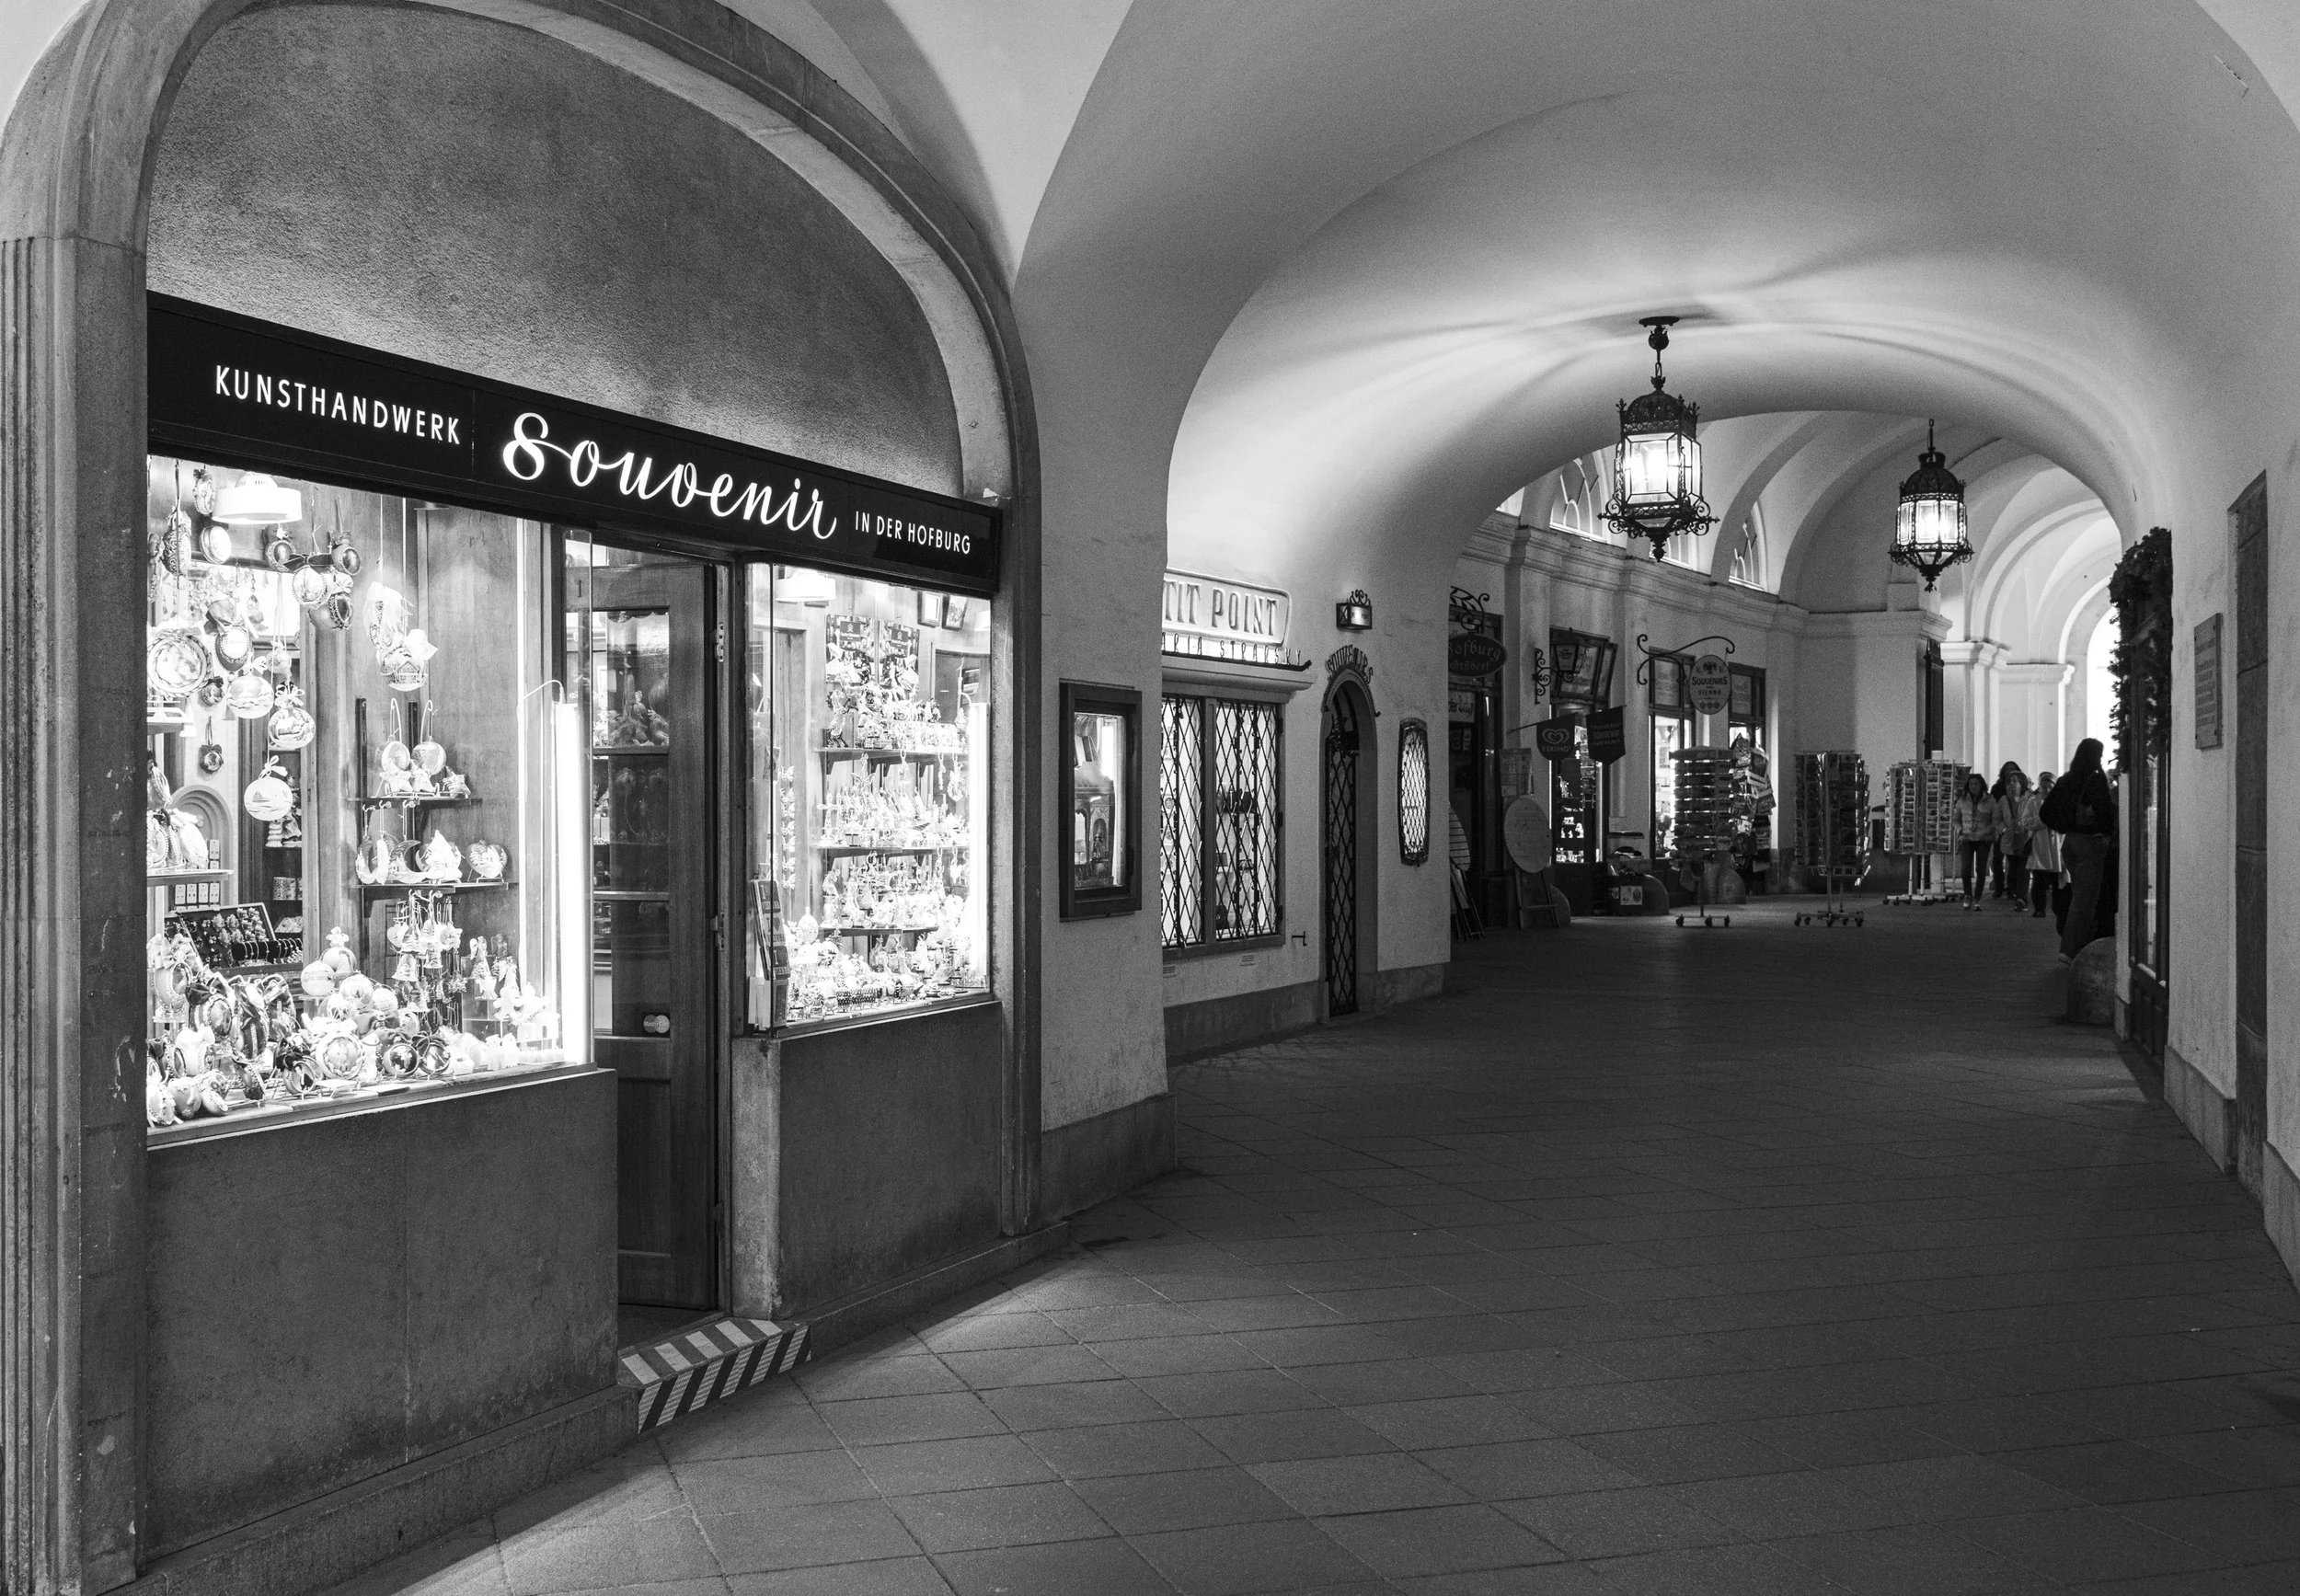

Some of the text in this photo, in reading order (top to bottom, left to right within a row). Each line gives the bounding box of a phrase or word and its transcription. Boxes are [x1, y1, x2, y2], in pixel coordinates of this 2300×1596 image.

[214, 364, 460, 445] KUNSTHANDWERK
[502, 412, 837, 540] Souvenir
[855, 511, 972, 555] IN DER HOFBURG
[1211, 588, 1279, 637] POINT
[1692, 676, 1728, 685] SOUVENIRS
